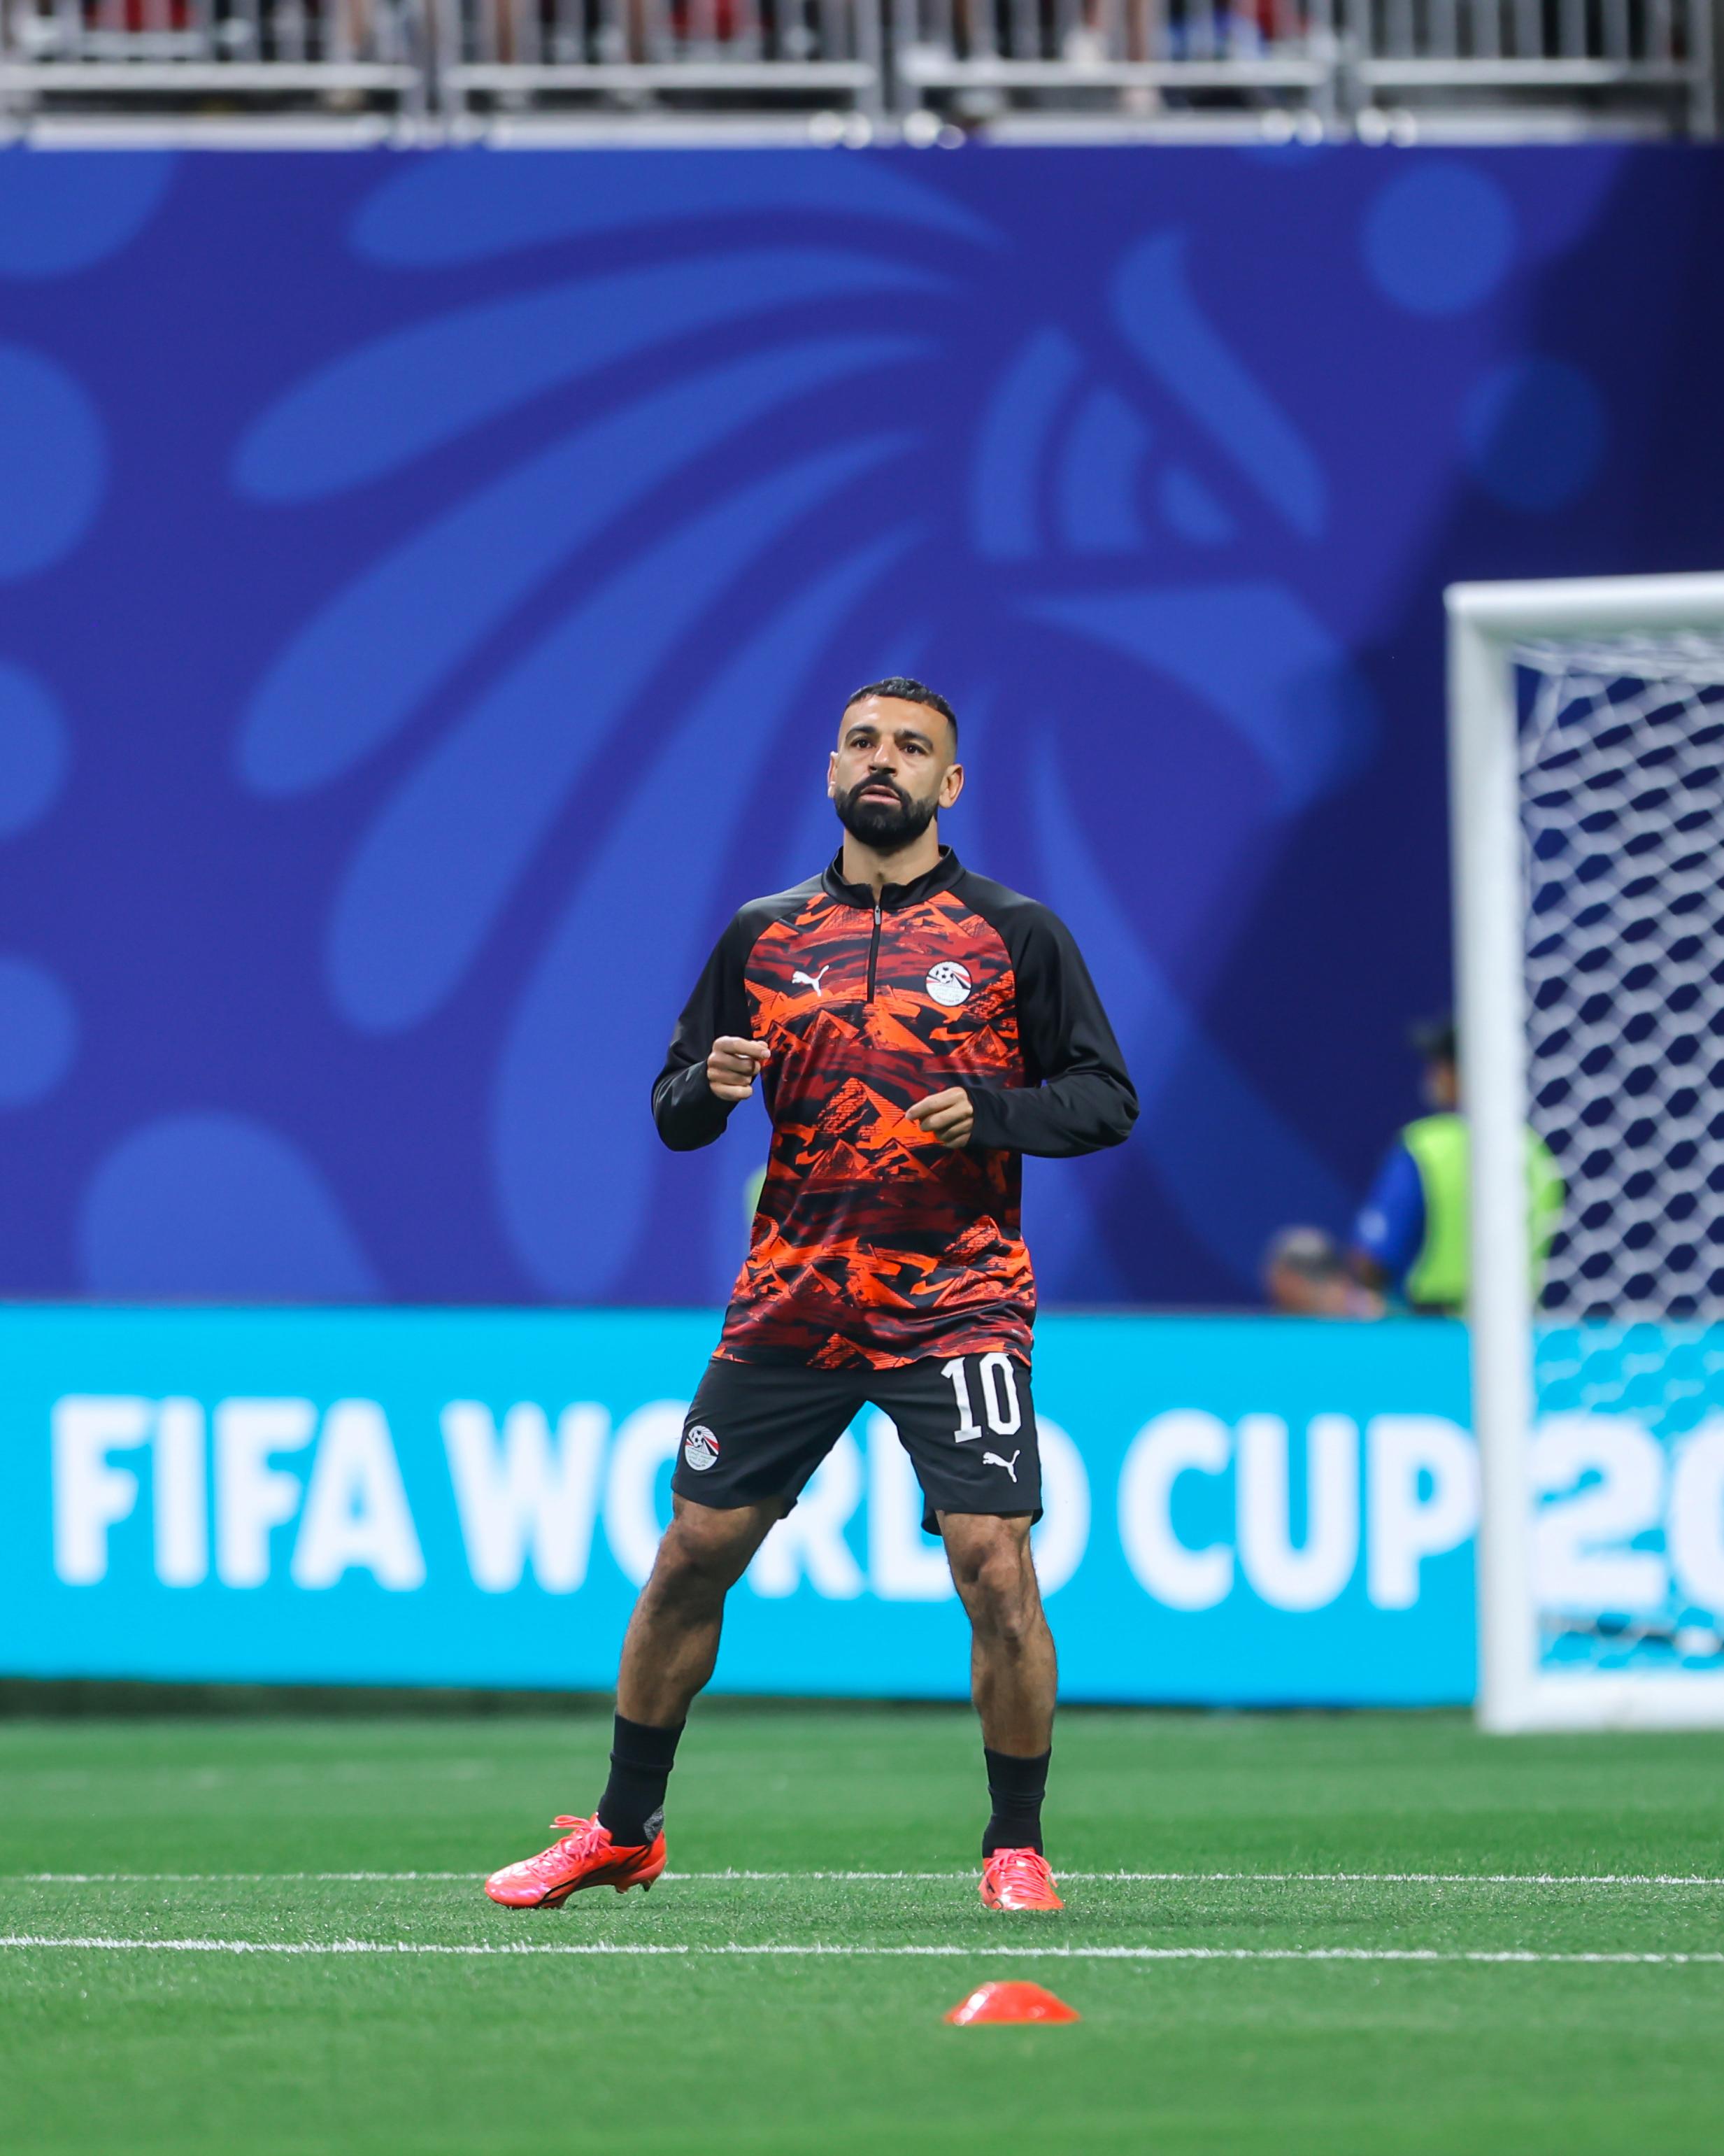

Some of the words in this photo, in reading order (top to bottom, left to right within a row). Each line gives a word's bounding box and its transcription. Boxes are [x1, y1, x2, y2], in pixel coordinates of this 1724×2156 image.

[941, 1352, 1022, 1443] 10
[52, 1395, 425, 1590] FIFA
[1118, 1407, 1478, 1612] CUP
